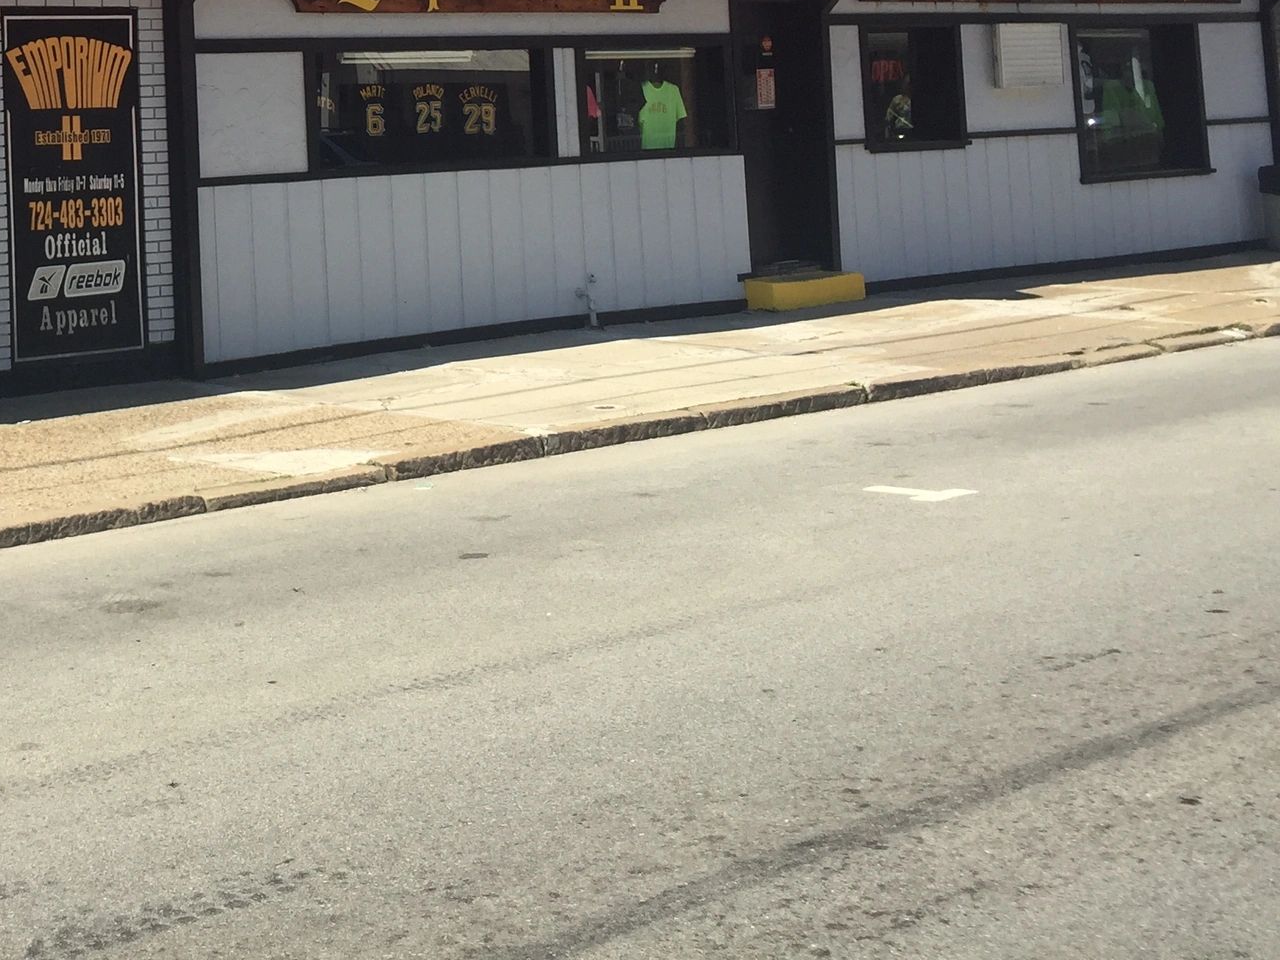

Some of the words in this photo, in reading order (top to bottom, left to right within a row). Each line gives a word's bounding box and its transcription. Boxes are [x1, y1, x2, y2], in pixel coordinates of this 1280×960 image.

[6, 36, 132, 110] EMPORIUM
[365, 103, 385, 137] 6
[415, 100, 443, 134] 25
[462, 103, 497, 135] 29
[35, 130, 89, 146] Established
[91, 129, 111, 143] 1971
[23, 177, 45, 194] Monday
[45, 176, 57, 192] thru
[57, 176, 75, 192] Friday
[89, 174, 113, 191] Saturday
[28, 197, 124, 230] 724-483-3303
[44, 231, 108, 259] Official
[69, 268, 120, 289] reebok
[39, 300, 117, 336] Apparel
